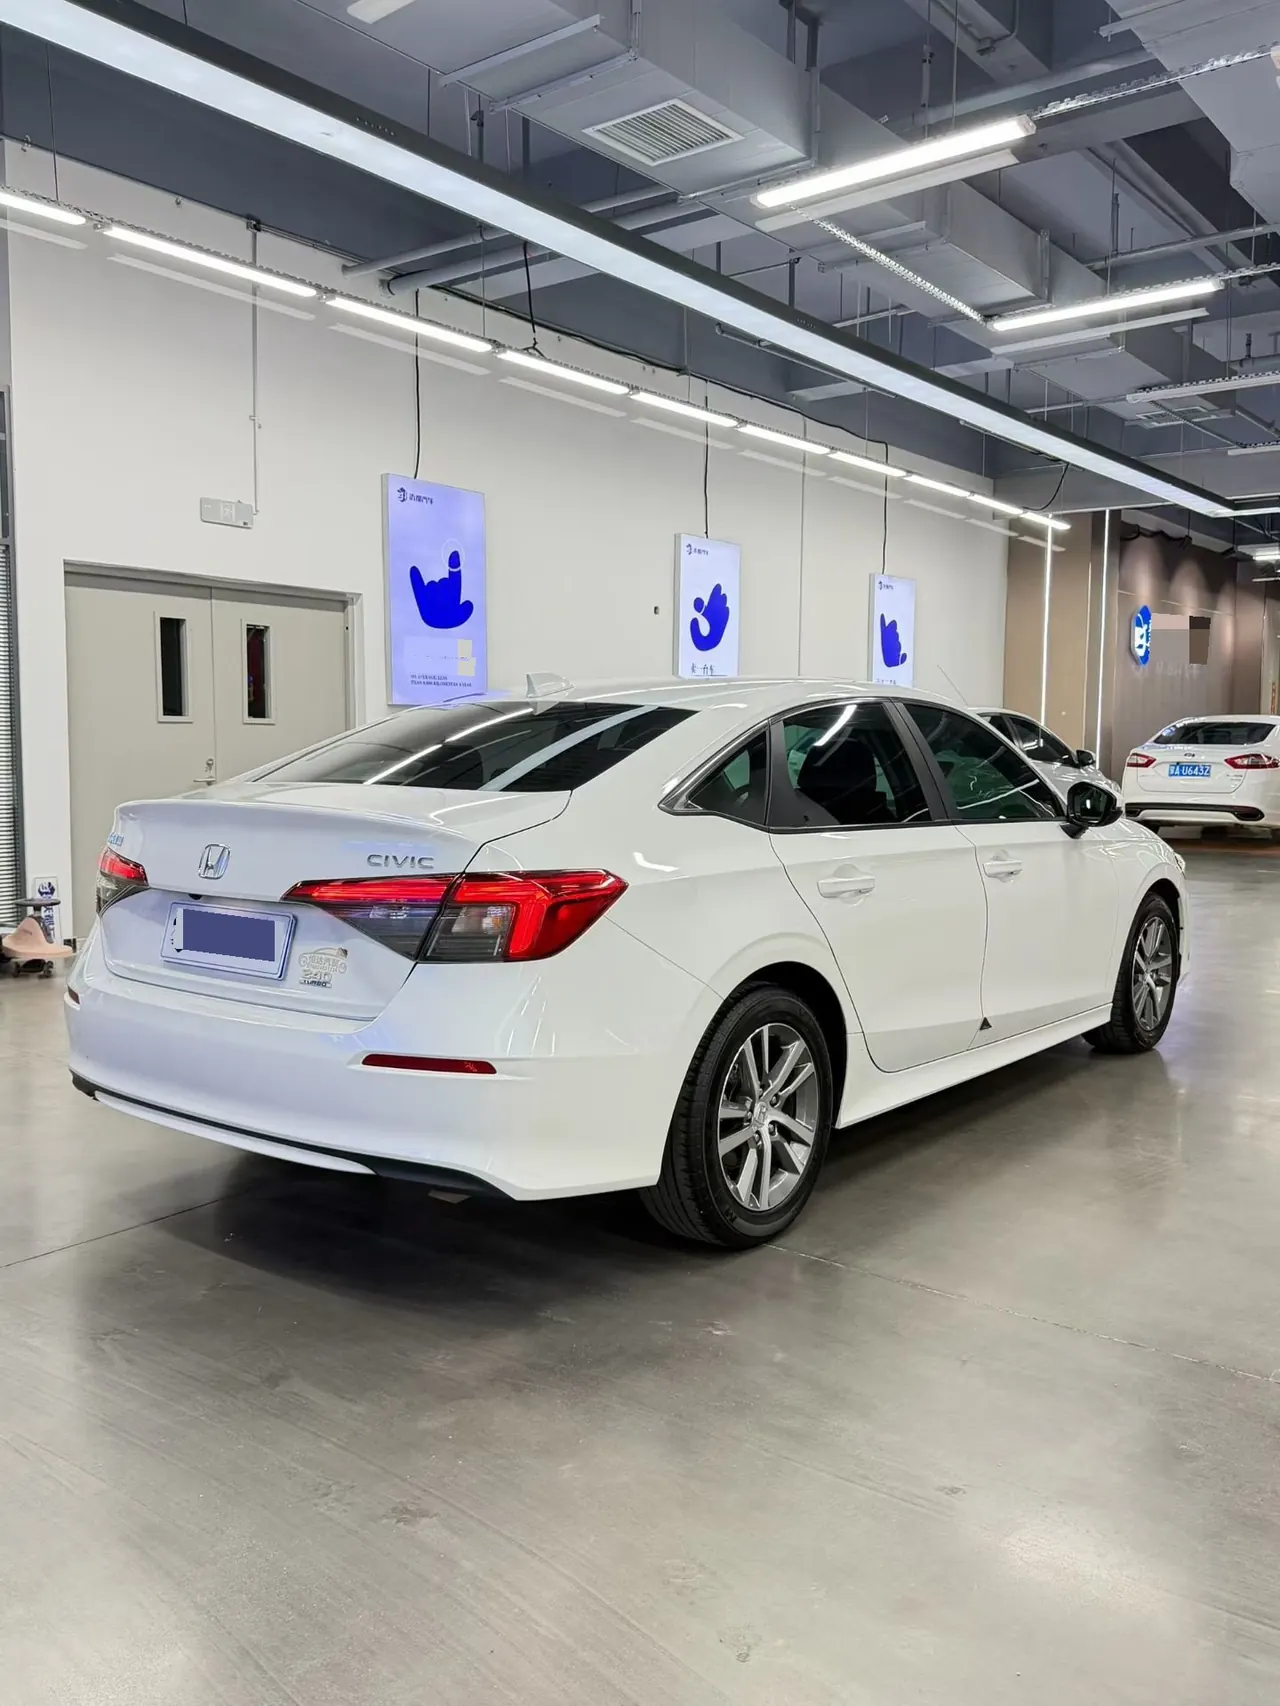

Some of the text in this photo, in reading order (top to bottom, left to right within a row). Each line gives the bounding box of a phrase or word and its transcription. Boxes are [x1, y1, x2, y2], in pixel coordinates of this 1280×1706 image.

[366, 854, 434, 869] CIVIC
[302, 968, 333, 981] 240
[303, 979, 327, 987] TURBO
